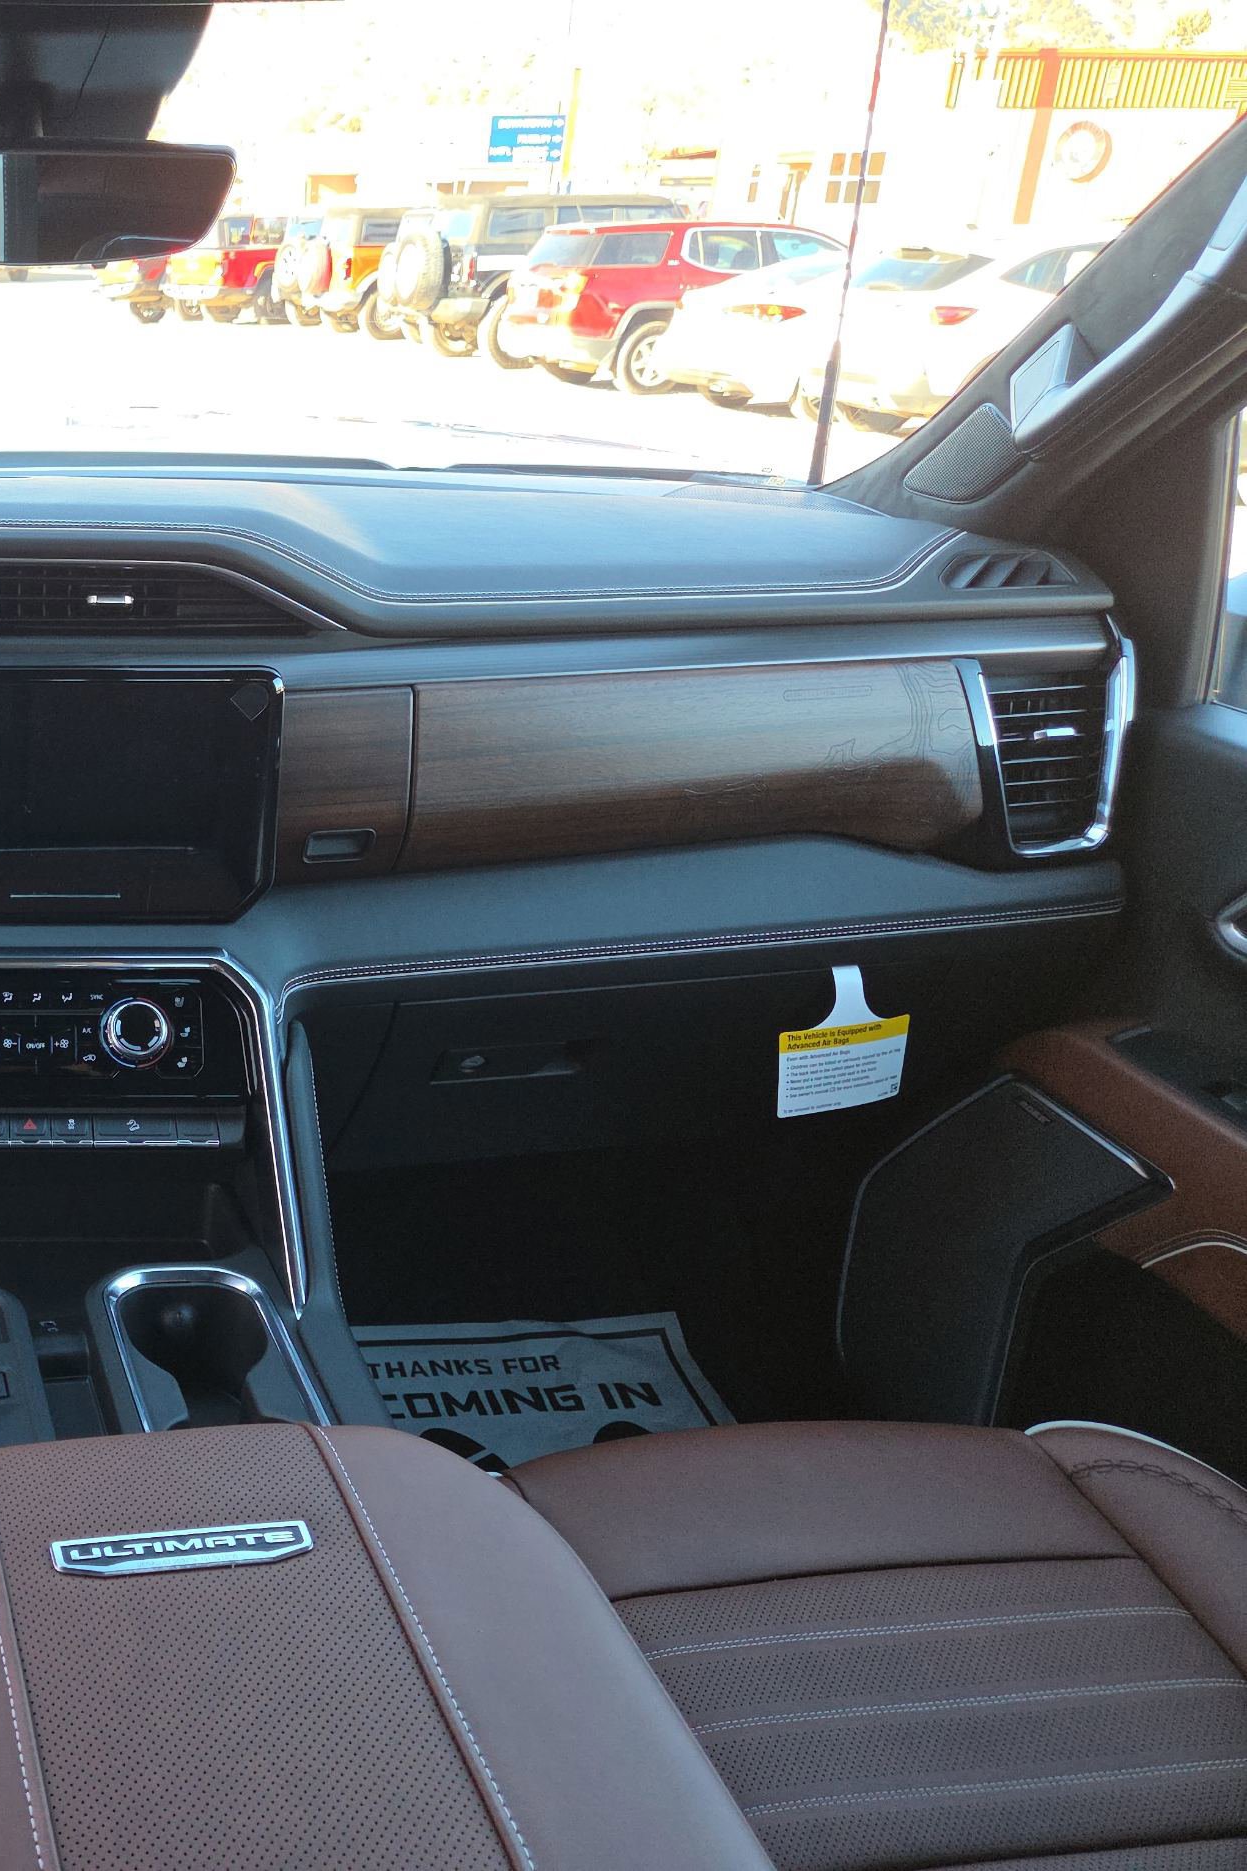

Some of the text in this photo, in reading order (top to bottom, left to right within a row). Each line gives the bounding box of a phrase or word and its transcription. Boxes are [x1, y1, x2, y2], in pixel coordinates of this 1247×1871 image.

[787, 1034, 801, 1042] This
[804, 1030, 828, 1040] Vehicle
[837, 1026, 867, 1037] Equipped
[787, 1041, 821, 1050] Advanced
[833, 1037, 850, 1046] Bags
[366, 1354, 562, 1380] THANKS FOR
[598, 1381, 663, 1410] IN
[70, 1531, 296, 1561] ULTIMATE
